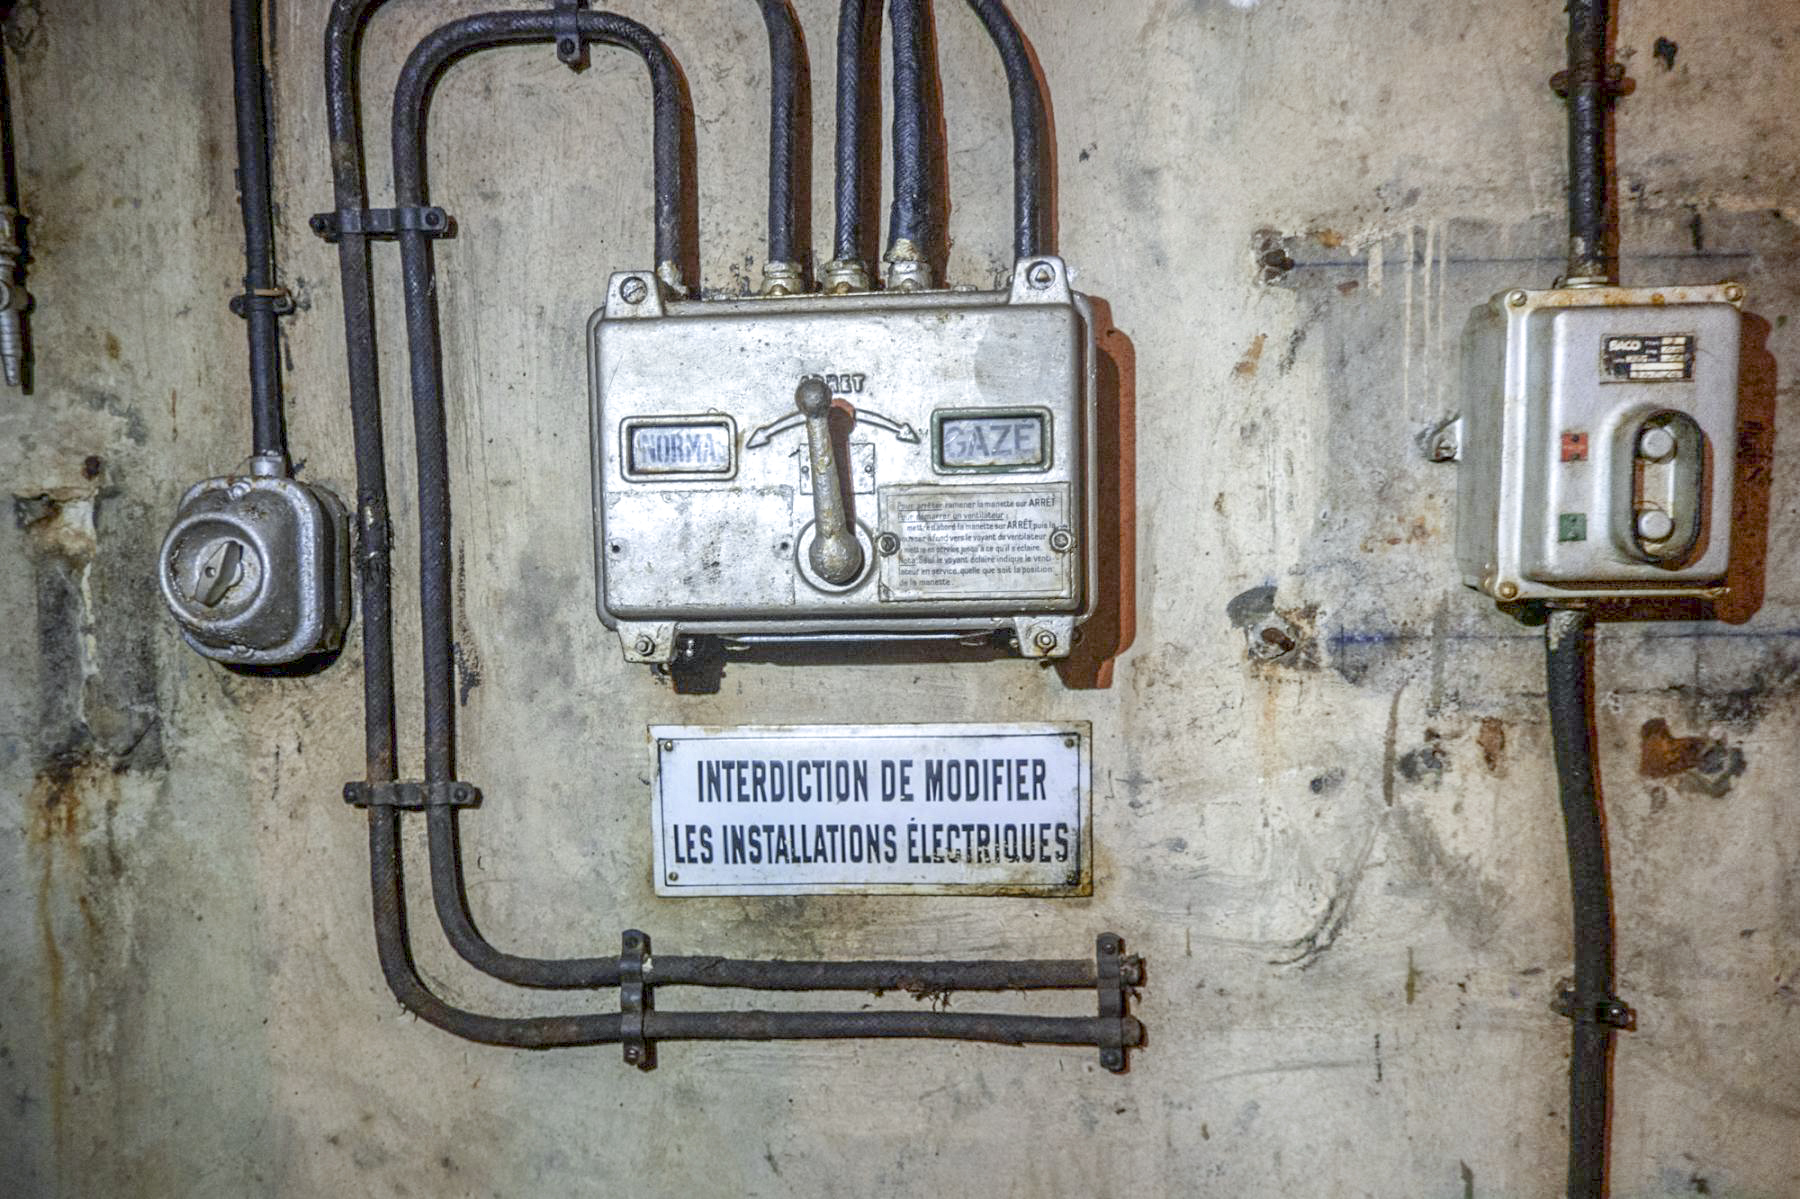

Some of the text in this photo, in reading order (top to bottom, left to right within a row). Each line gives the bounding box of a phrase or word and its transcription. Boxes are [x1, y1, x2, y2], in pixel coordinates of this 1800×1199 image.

[973, 534, 996, 542] voyant
[1007, 532, 1046, 540] ventilateur
[945, 556, 968, 565] voyant
[997, 554, 1023, 564] indique
[960, 566, 980, 576] quelle
[983, 567, 995, 577] que
[1022, 565, 1053, 575] position
[697, 759, 1047, 803] INTERDICTION DE MODIFIER
[673, 818, 1069, 864] LES INSTALLATIONS ÉLECTRIQUES
